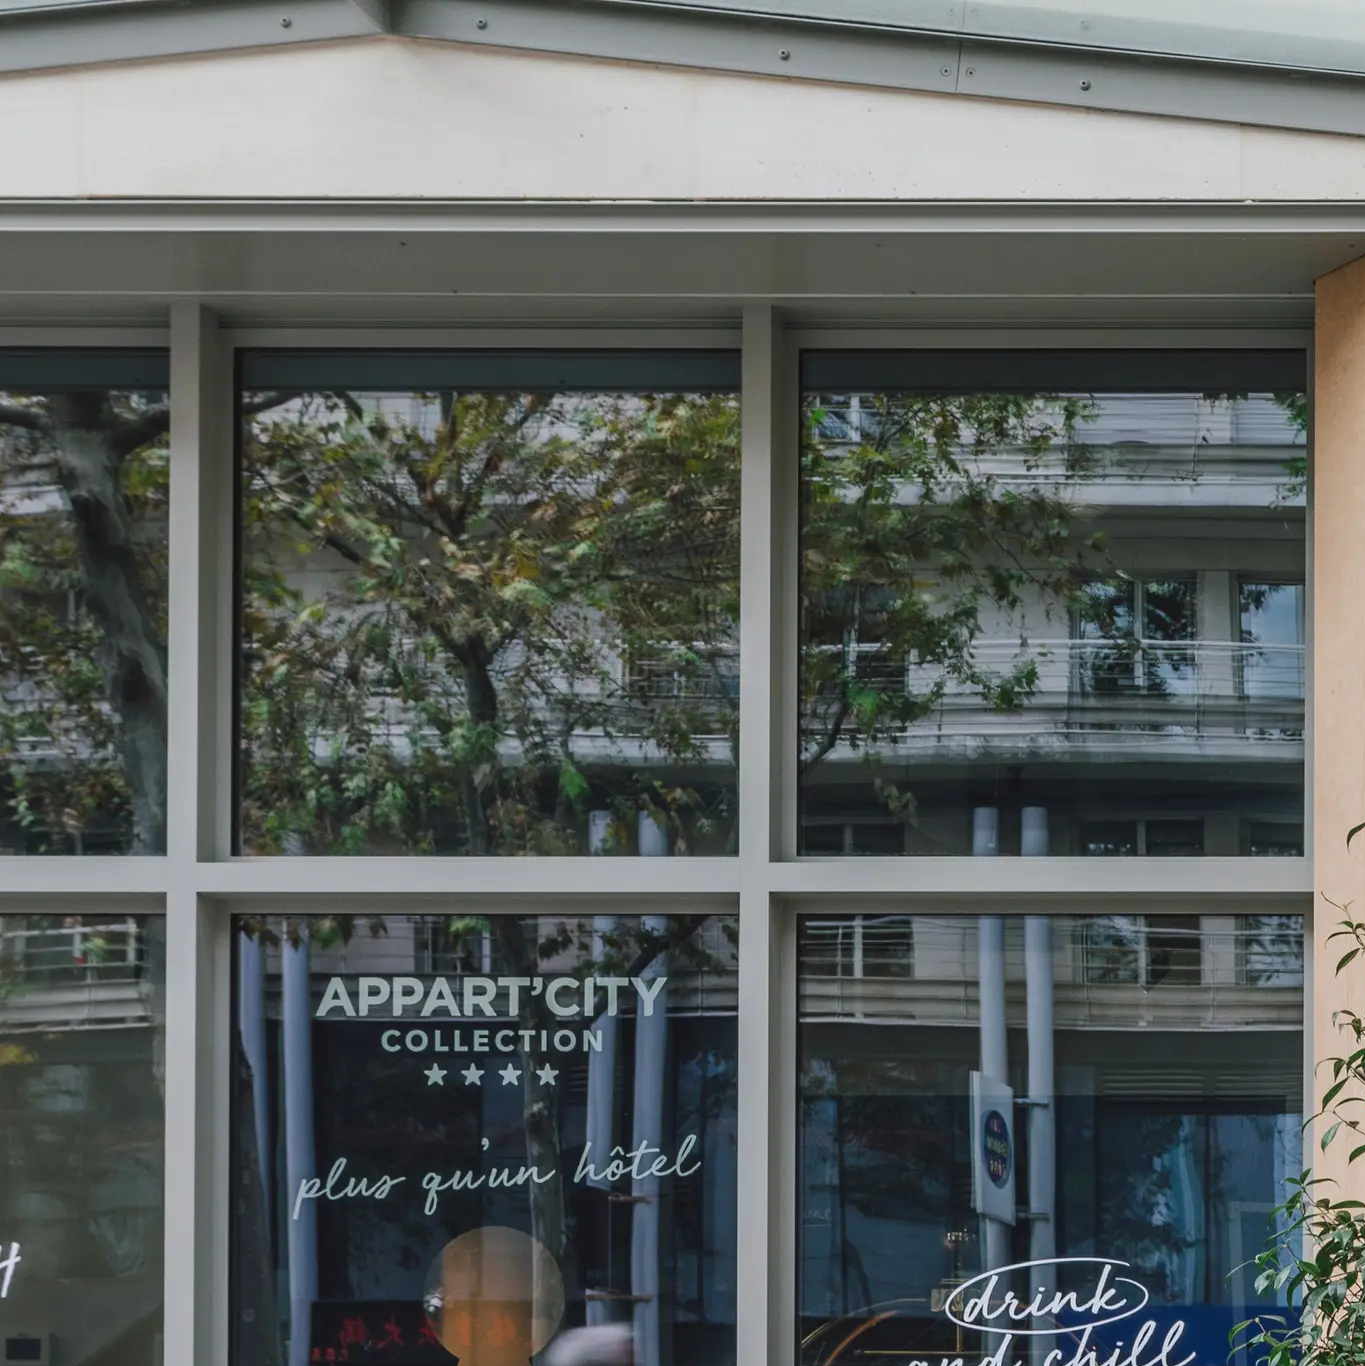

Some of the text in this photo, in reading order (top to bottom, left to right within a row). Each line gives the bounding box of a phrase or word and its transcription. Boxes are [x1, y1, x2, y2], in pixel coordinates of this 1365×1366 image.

[316, 976, 668, 1016] APPART'CITY
[381, 1029, 603, 1052] COLLECTION
[292, 1157, 406, 1221] plus
[574, 1133, 702, 1184] hôtel
[963, 1264, 1127, 1322] drink
